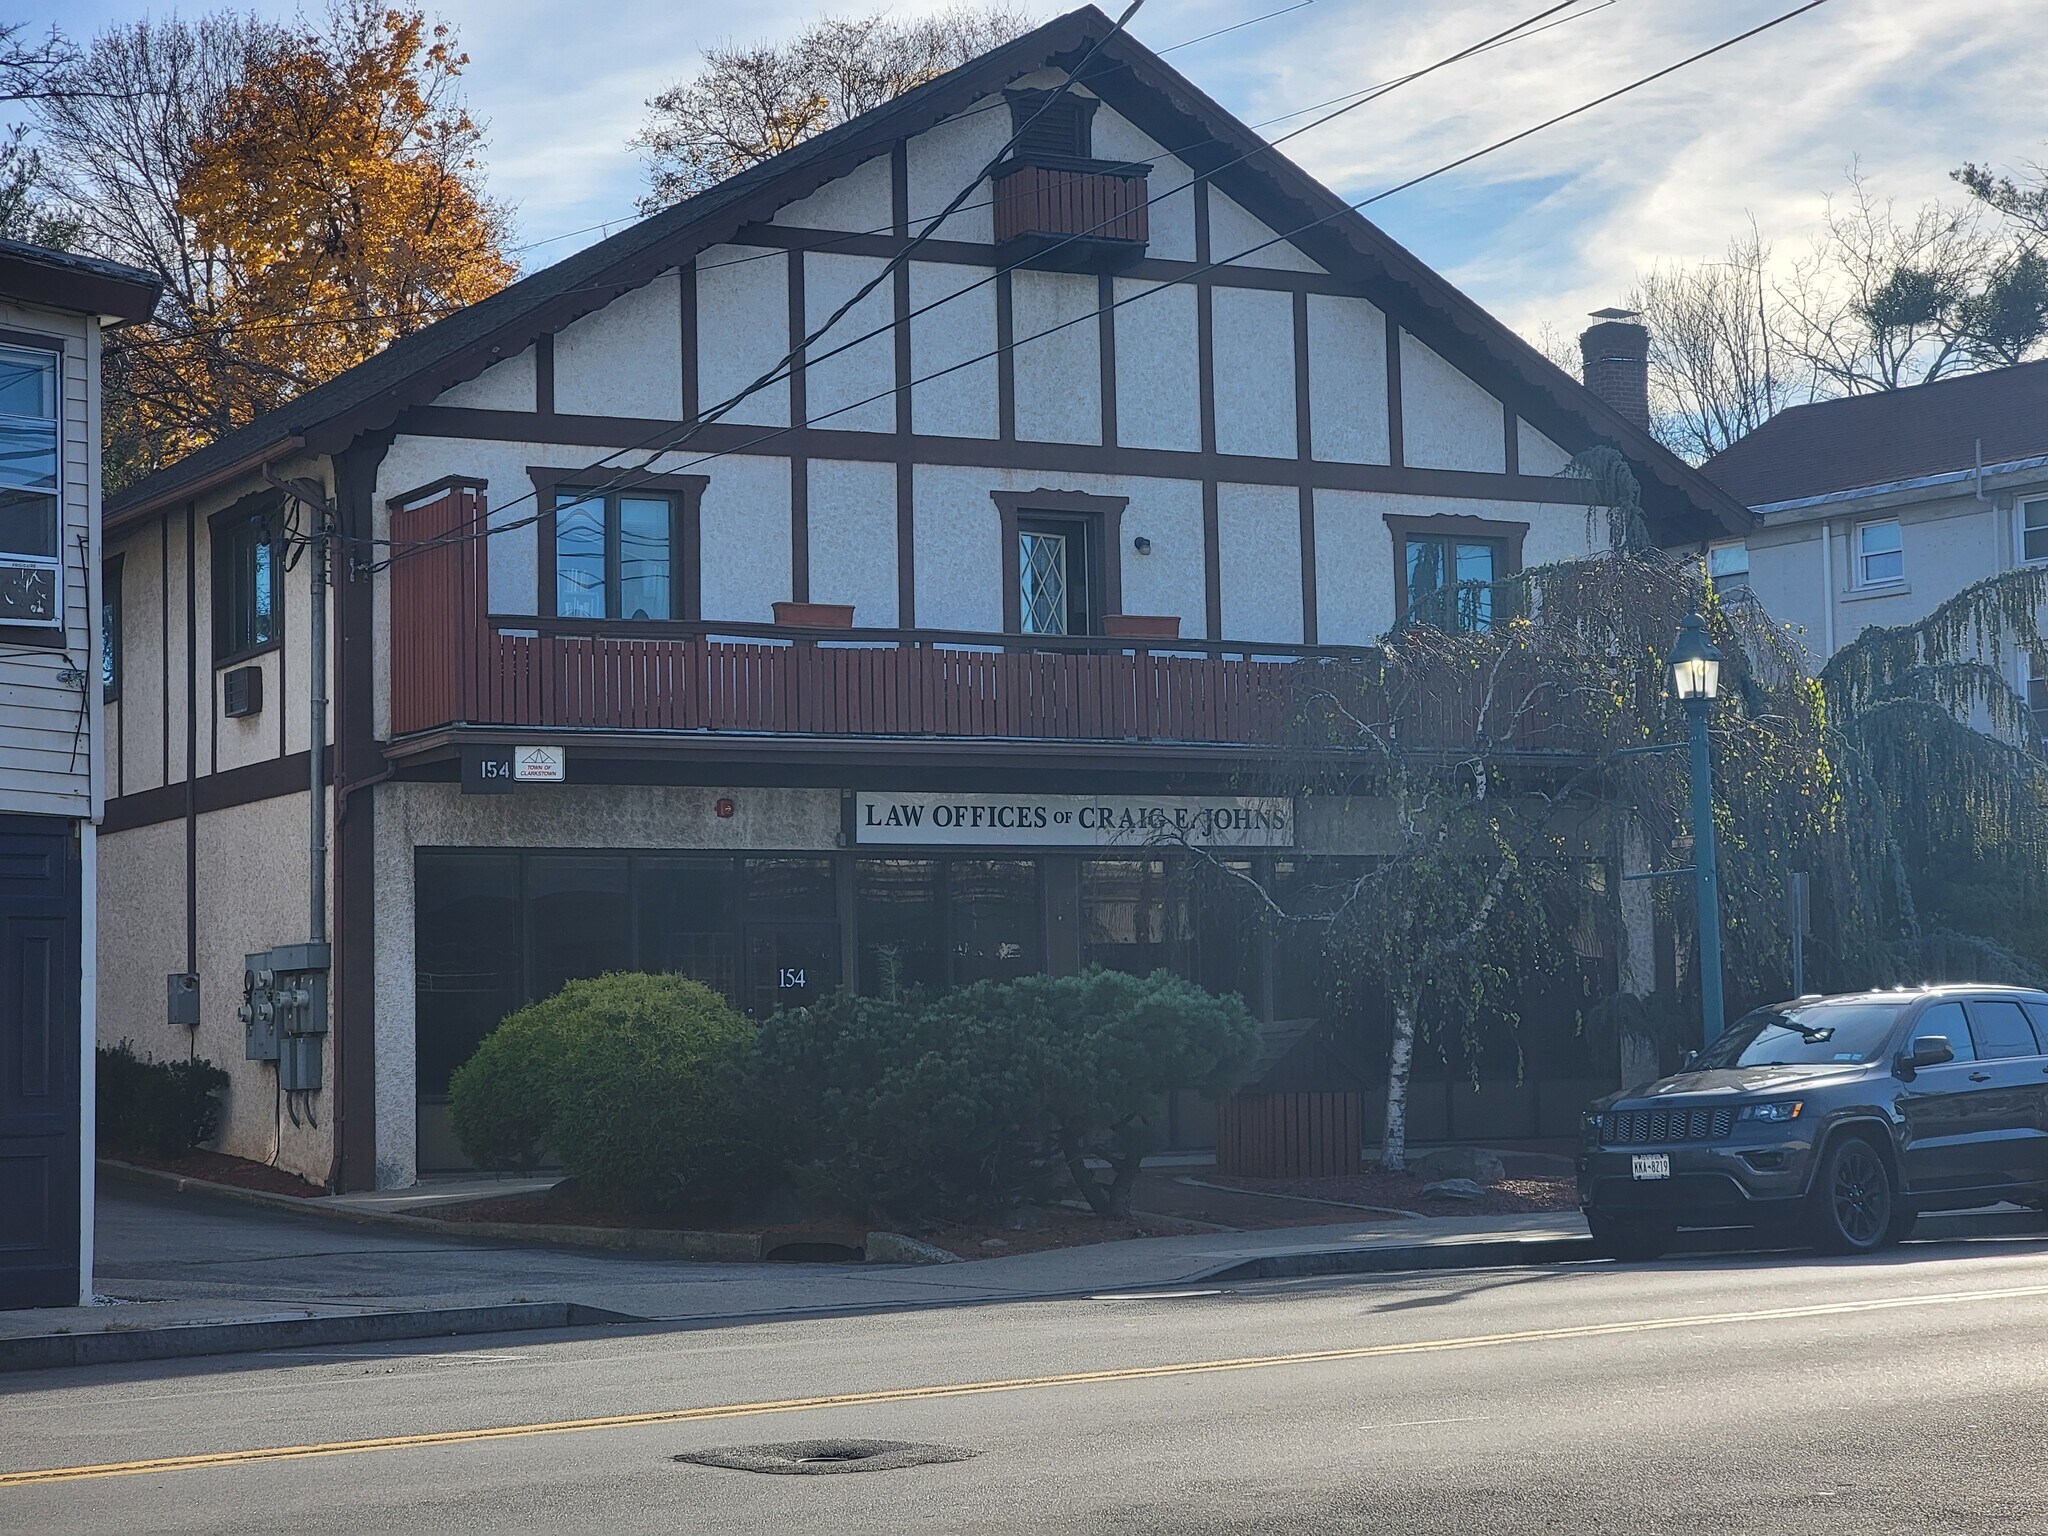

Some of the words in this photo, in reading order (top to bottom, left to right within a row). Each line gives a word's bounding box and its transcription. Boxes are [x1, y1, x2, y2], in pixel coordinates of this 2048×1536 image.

[481, 761, 510, 778] 154
[865, 804, 924, 827] LAW
[933, 805, 1047, 828] OFFICES
[1053, 811, 1073, 824] OF
[1078, 807, 1165, 829] CRAIG
[1202, 808, 1285, 837] JOHNS
[779, 968, 806, 988] 154
